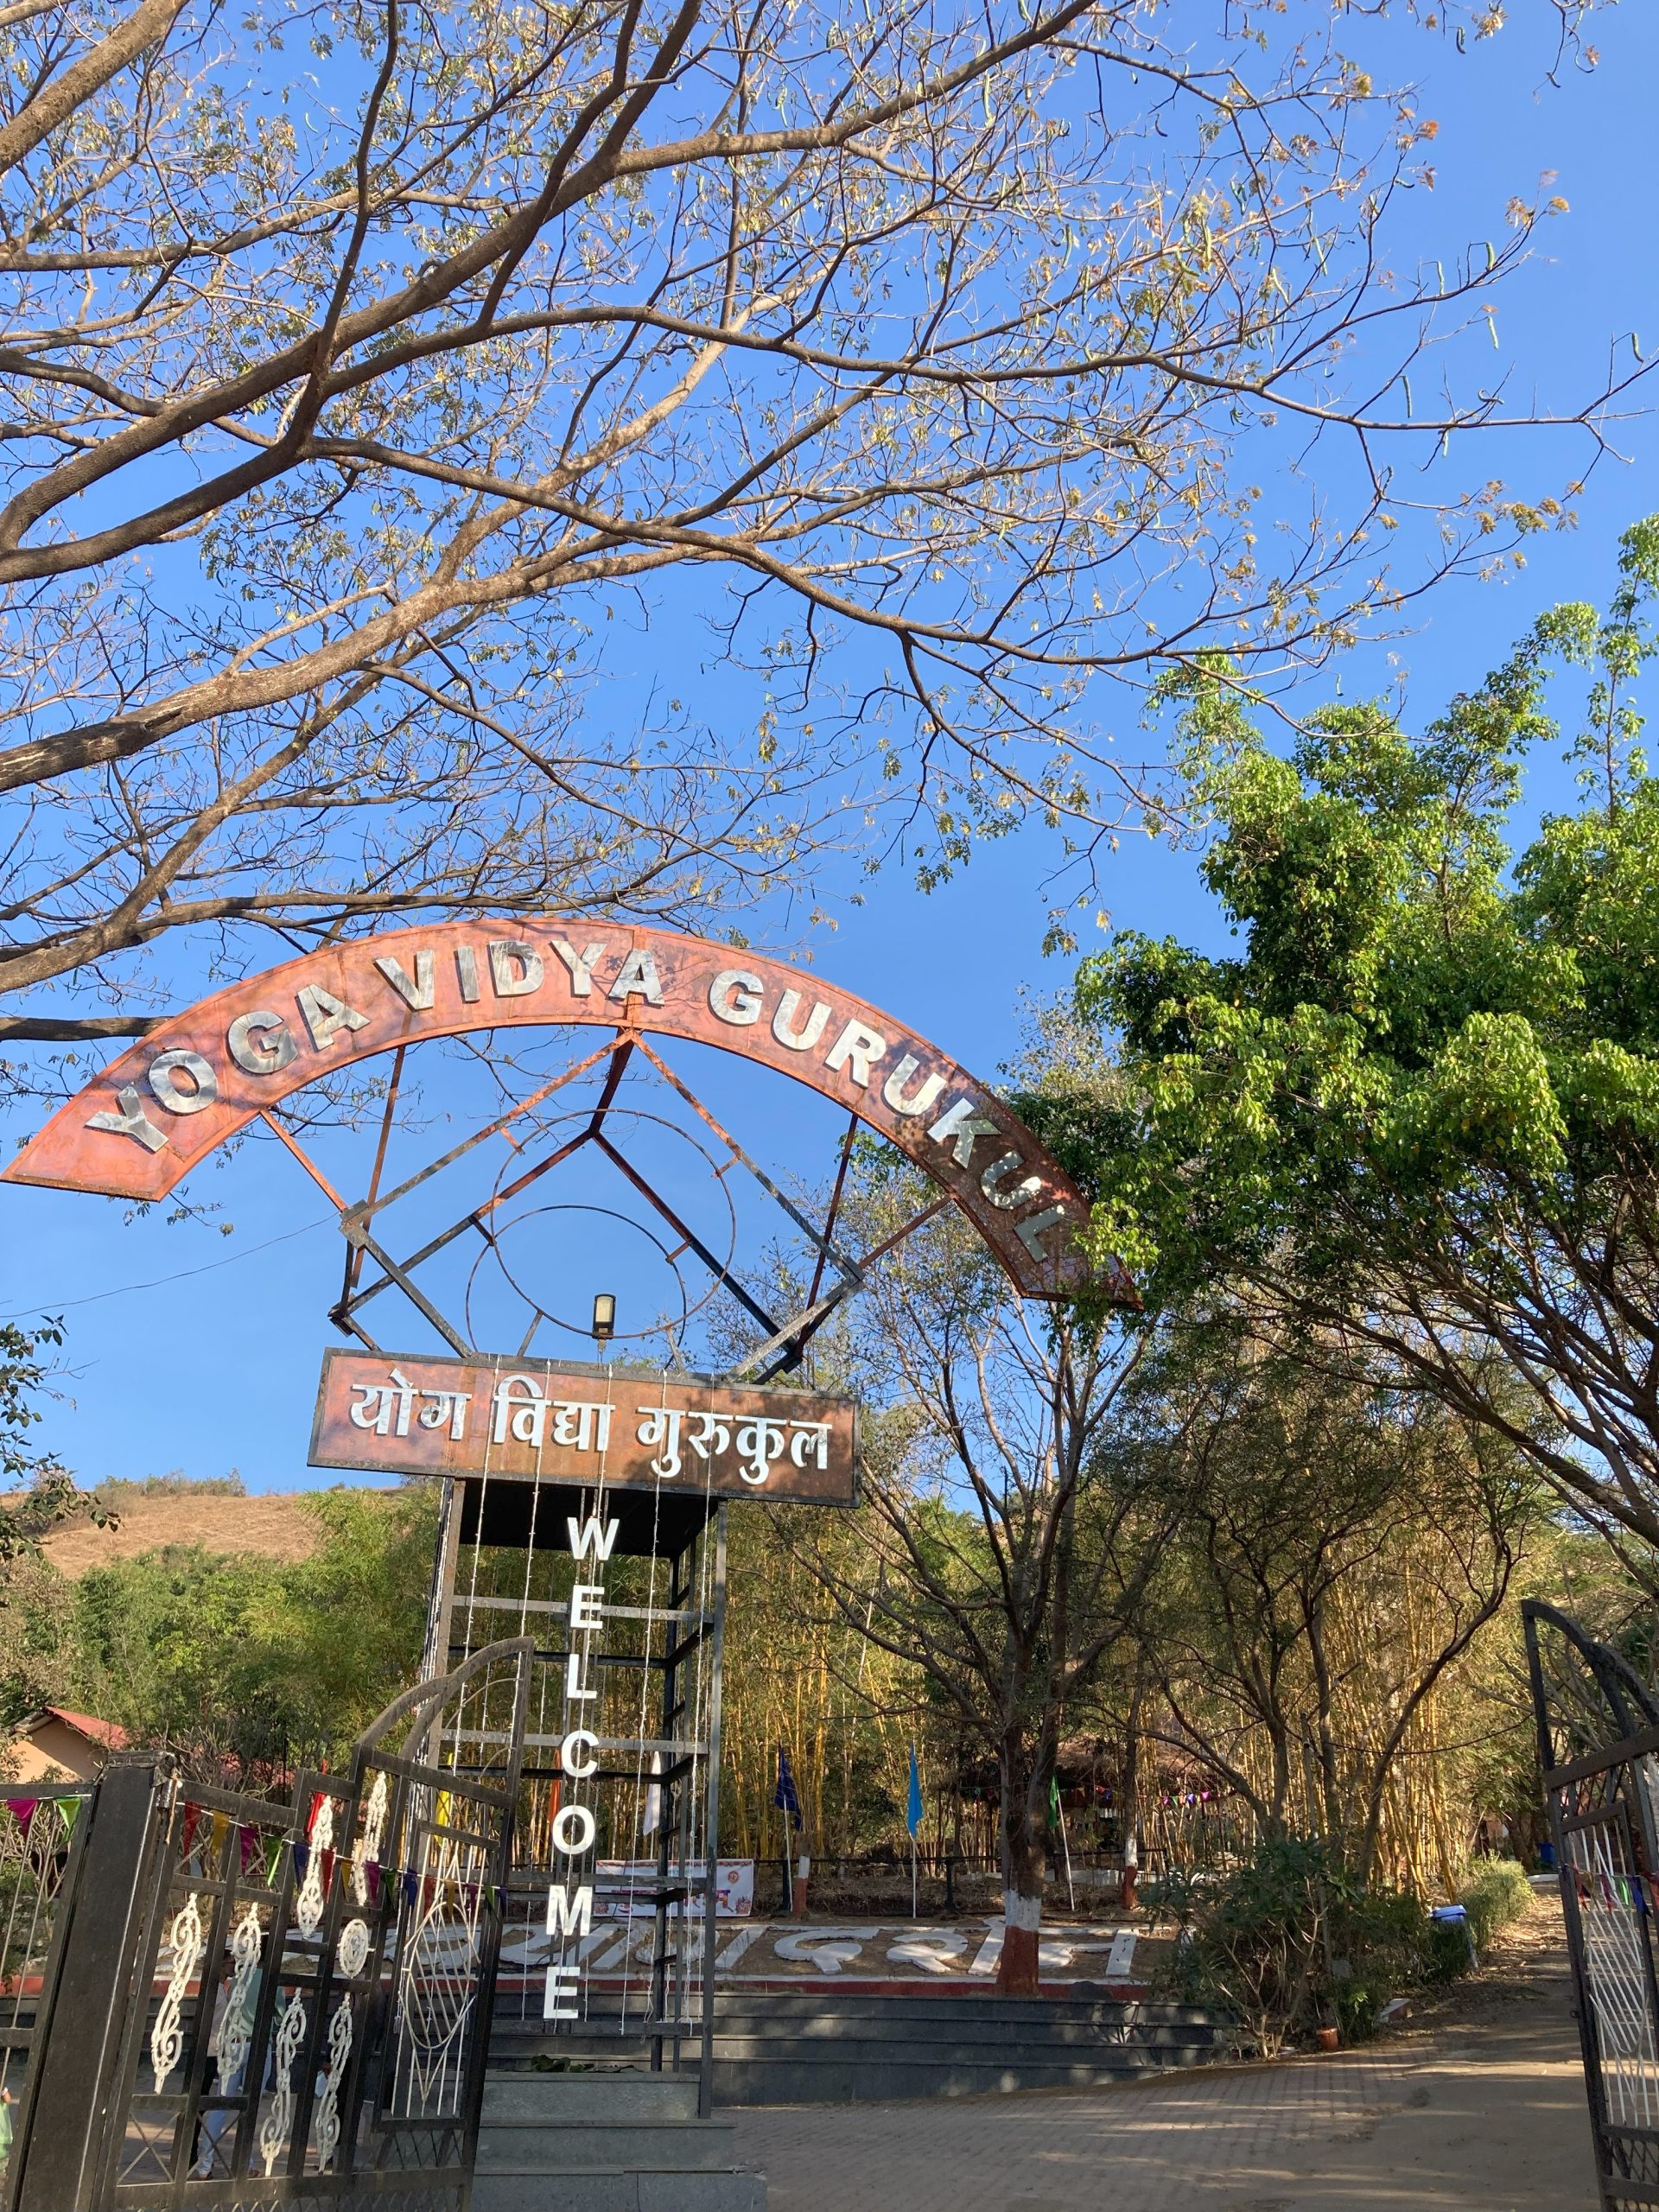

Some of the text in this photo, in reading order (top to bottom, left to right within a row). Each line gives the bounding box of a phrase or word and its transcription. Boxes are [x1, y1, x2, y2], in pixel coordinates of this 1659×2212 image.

[84, 939, 1066, 1263] YOGA VIDYA GURUKUL
[350, 1367, 472, 1441] योग
[637, 1405, 833, 1485] गुरुकुल
[543, 1516, 620, 2020] WELCOME
